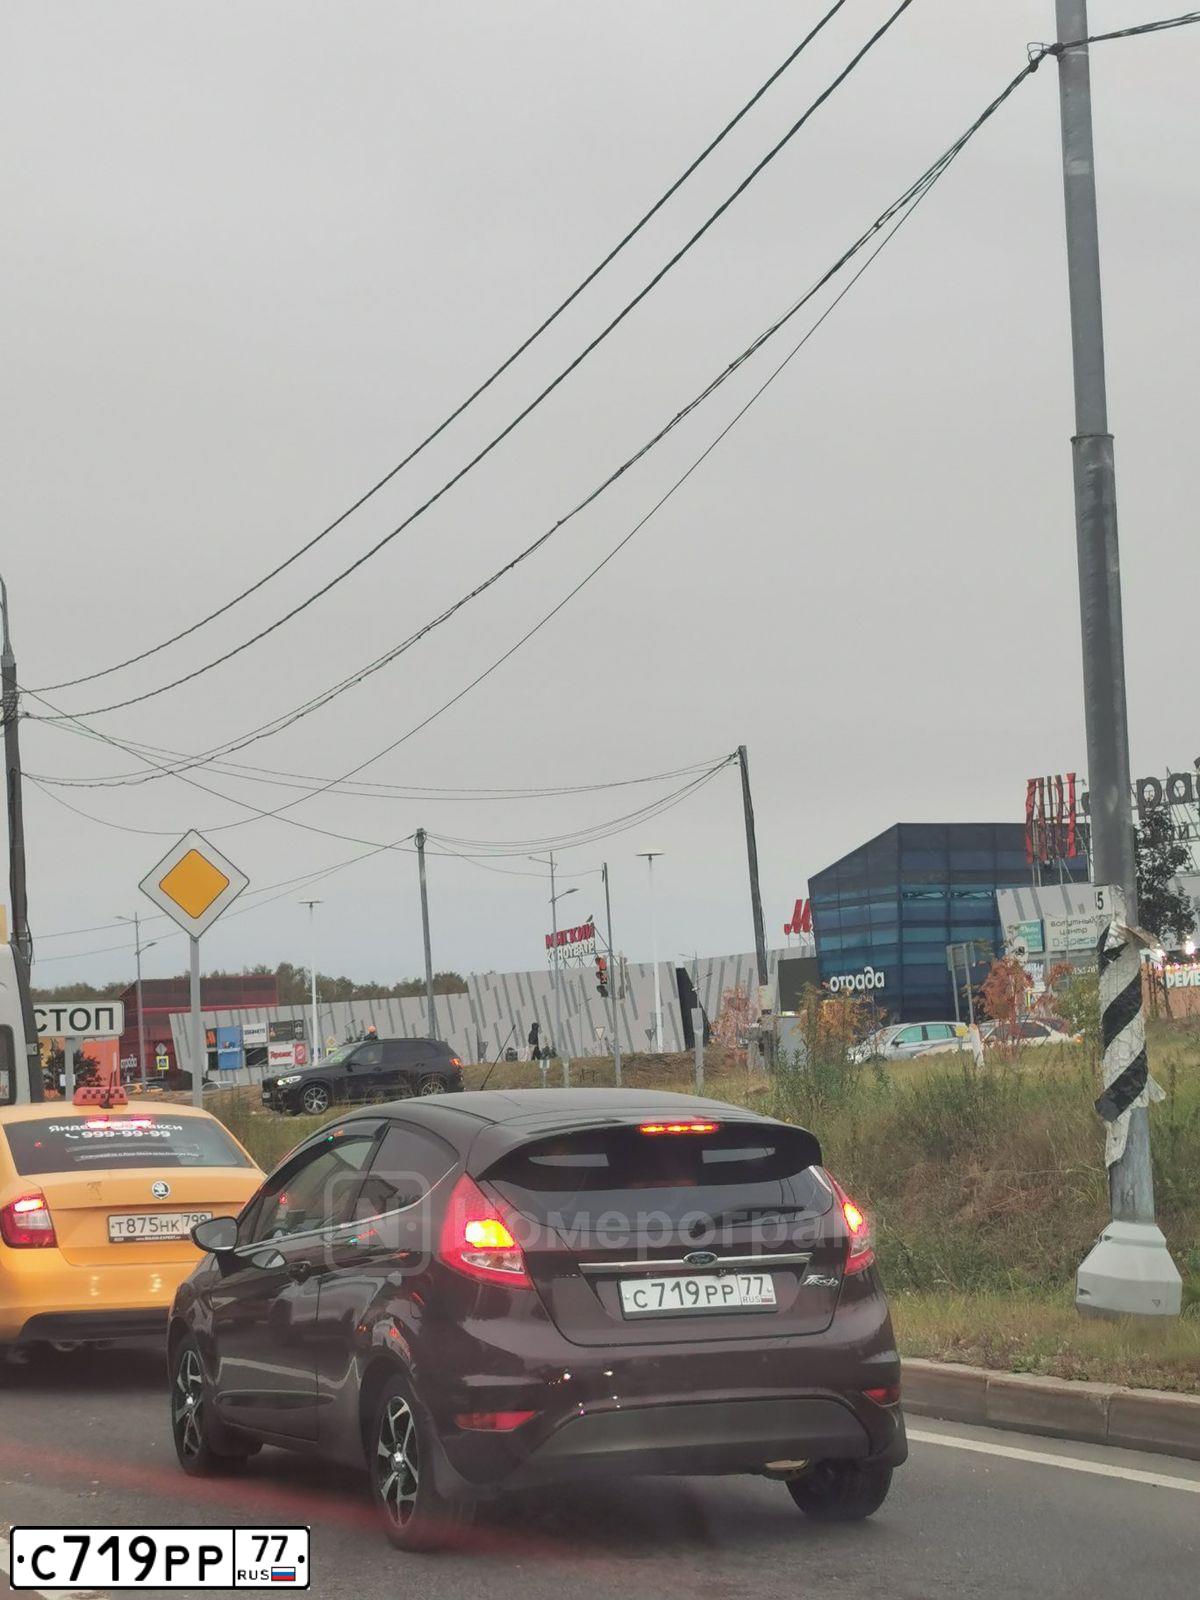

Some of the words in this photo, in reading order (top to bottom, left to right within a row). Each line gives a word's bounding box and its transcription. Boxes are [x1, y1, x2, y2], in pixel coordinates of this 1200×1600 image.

[115, 1217, 180, 1234] Т875НК
[633, 1280, 734, 1308] С719РР
[740, 1277, 764, 1295] 77
